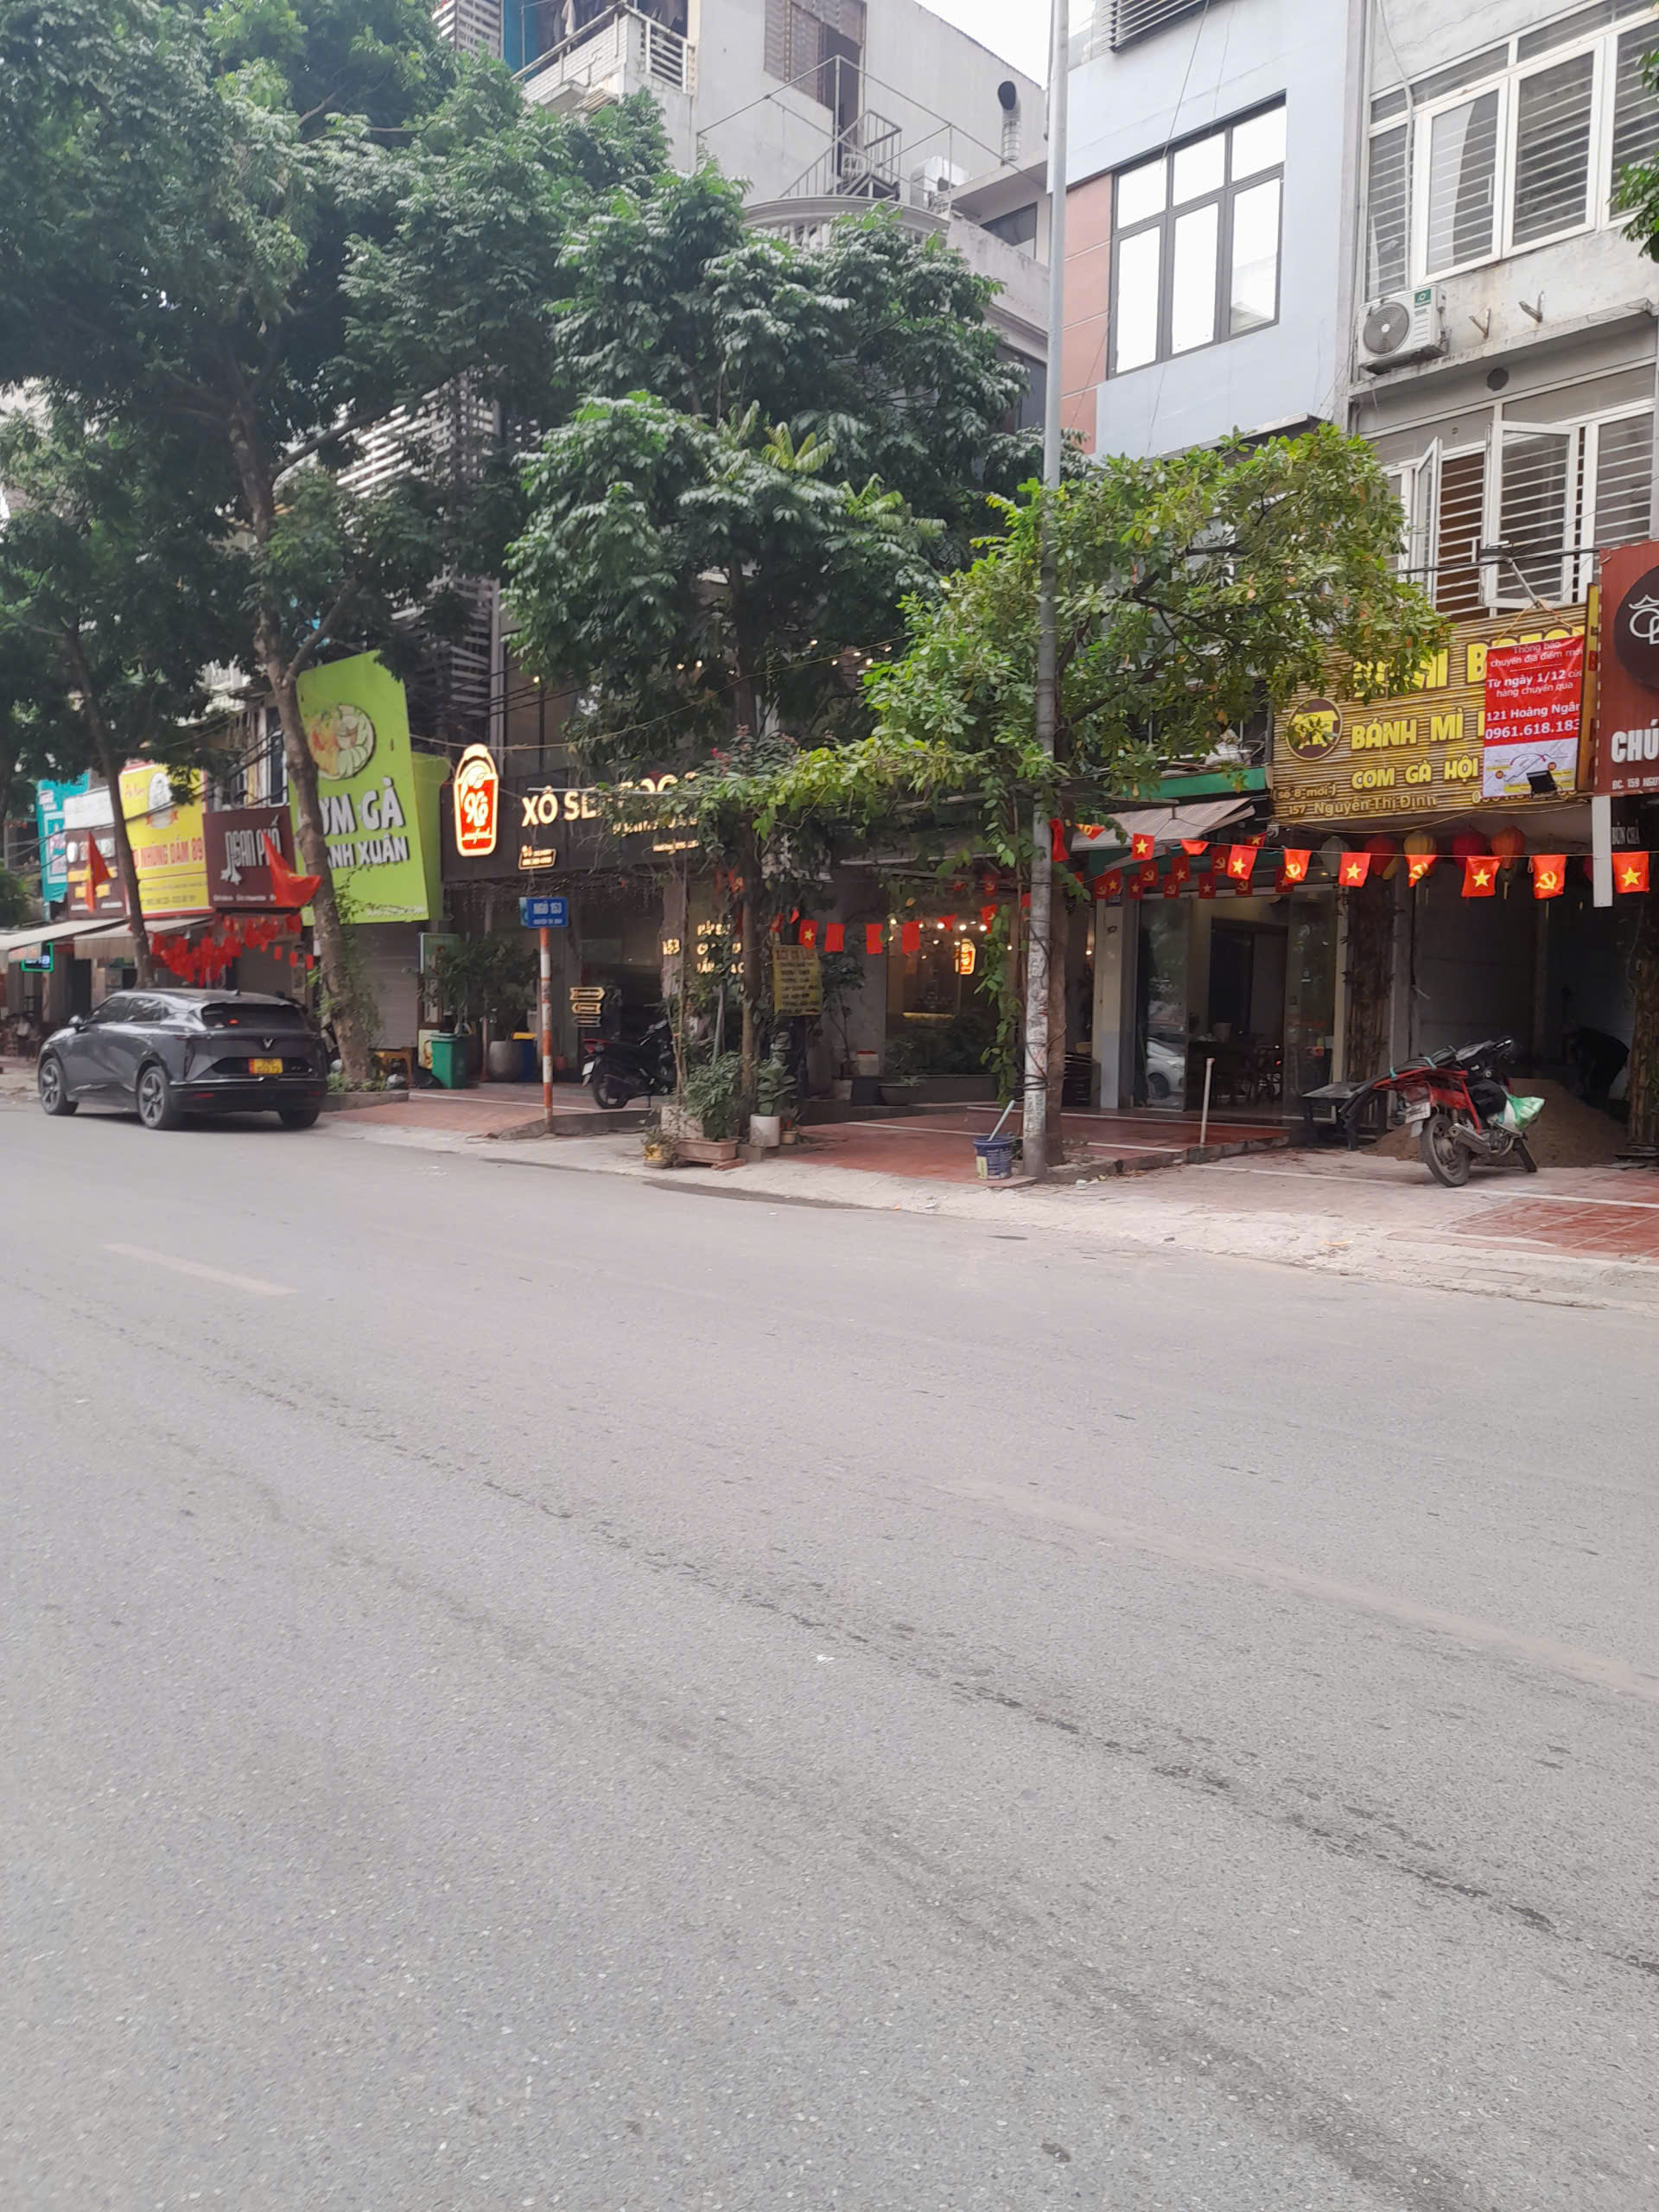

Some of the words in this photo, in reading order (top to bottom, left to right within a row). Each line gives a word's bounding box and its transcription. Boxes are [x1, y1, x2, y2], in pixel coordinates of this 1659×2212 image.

[1504, 674, 1533, 688] ngày
[1537, 670, 1566, 683] 1/12
[1351, 718, 1418, 750] BÁNH
[1430, 708, 1465, 742] MÌ
[1487, 709, 1507, 722] 121
[1510, 706, 1548, 720] Hoàng
[1405, 760, 1432, 784] GÀ
[1445, 754, 1478, 782] HỘI
[360, 776, 406, 830] GÀ
[522, 785, 558, 827] XÔ
[358, 834, 411, 866] XUÂN
